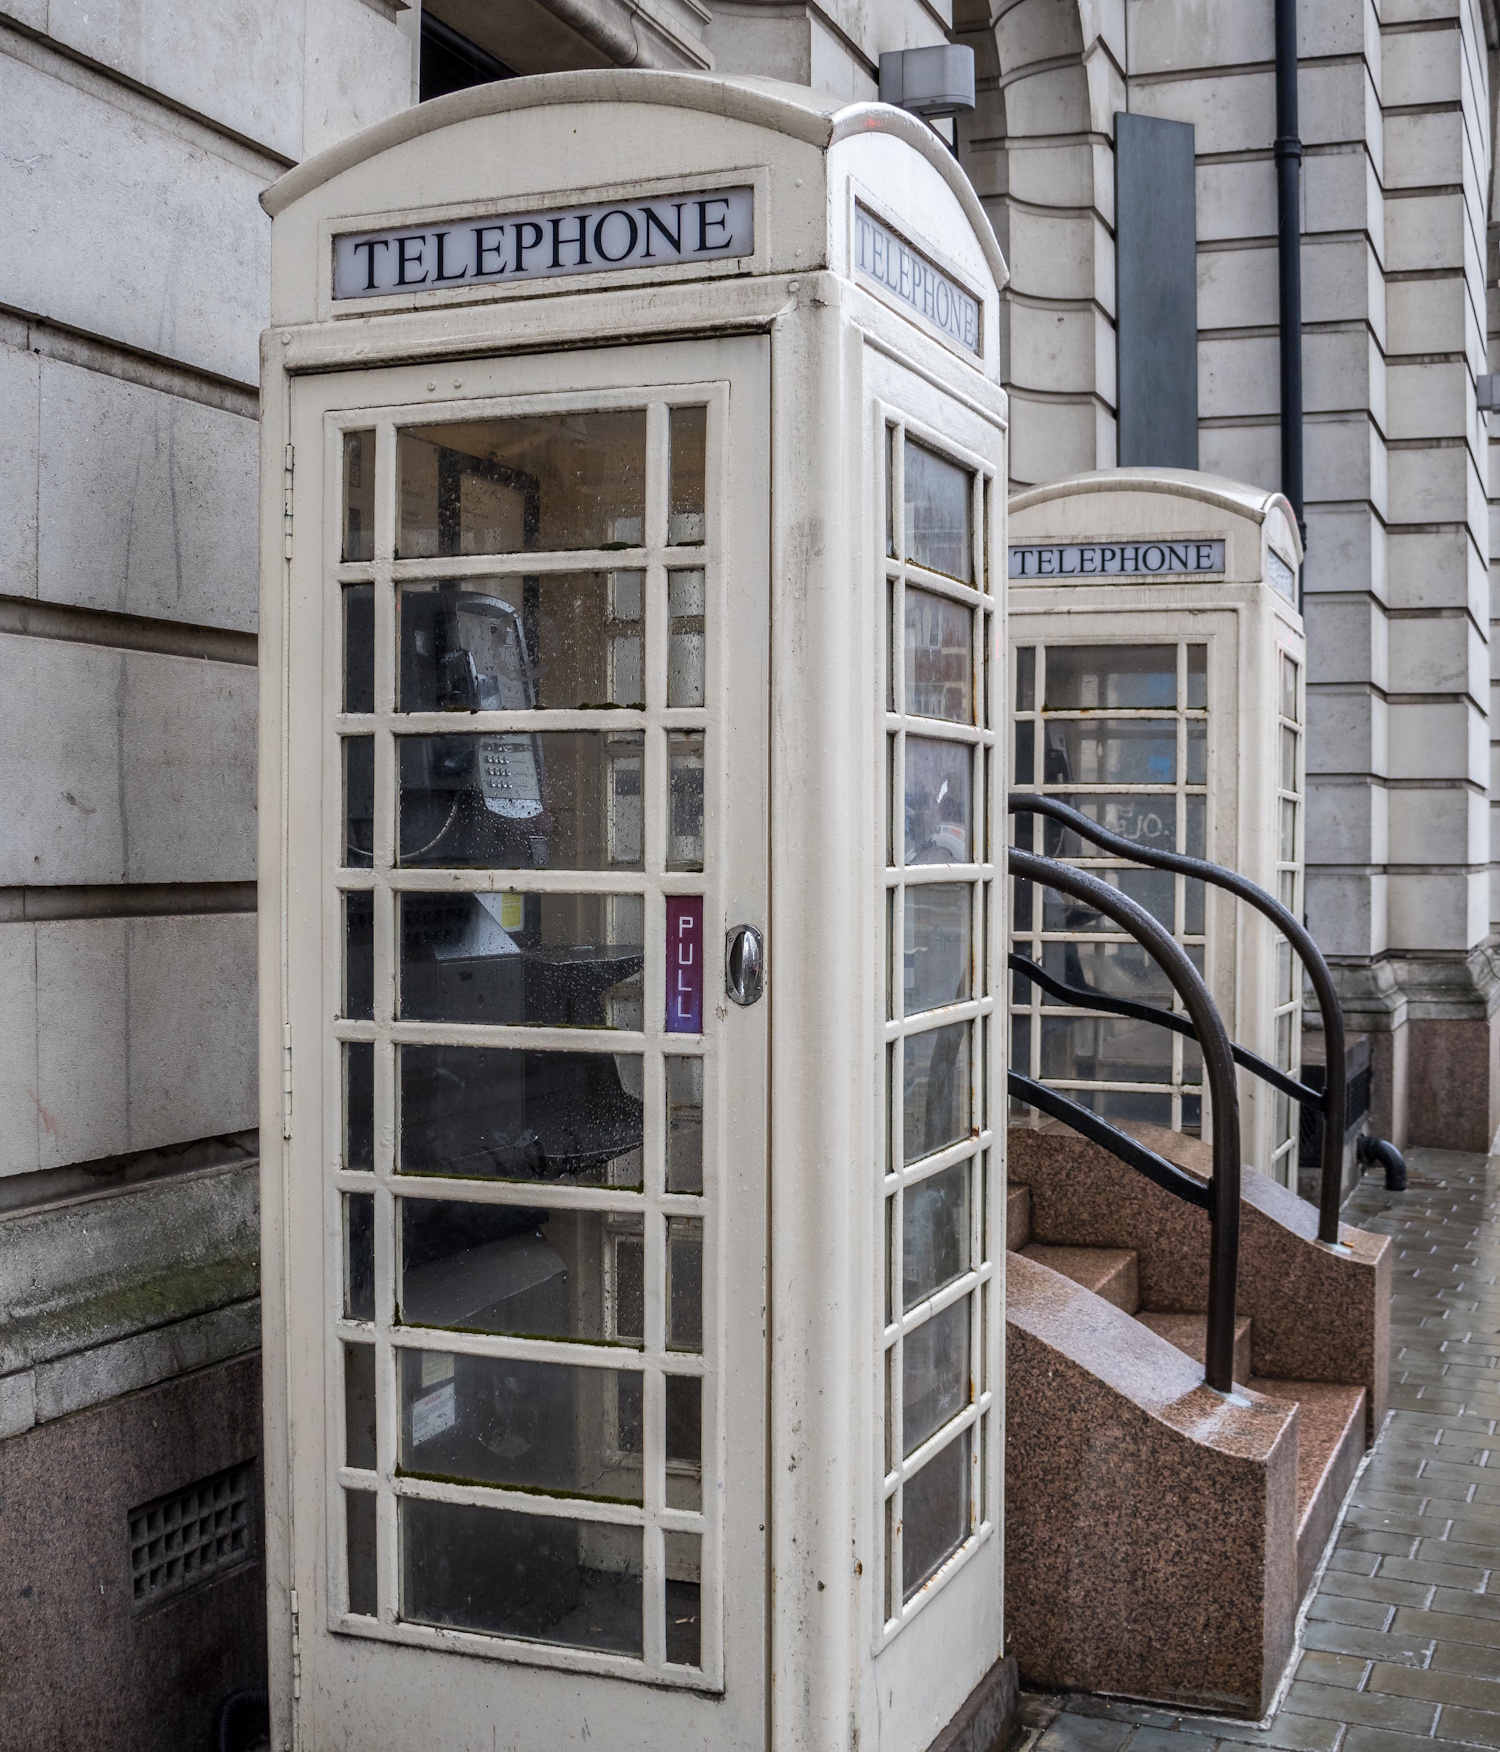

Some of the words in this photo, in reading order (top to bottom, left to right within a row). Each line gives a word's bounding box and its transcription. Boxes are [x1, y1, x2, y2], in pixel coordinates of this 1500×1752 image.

[353, 198, 733, 290] TELEPHONE
[855, 213, 975, 348] TELEPHONE
[1013, 543, 1214, 576] TELEPHONE
[677, 916, 694, 1018] PULL
